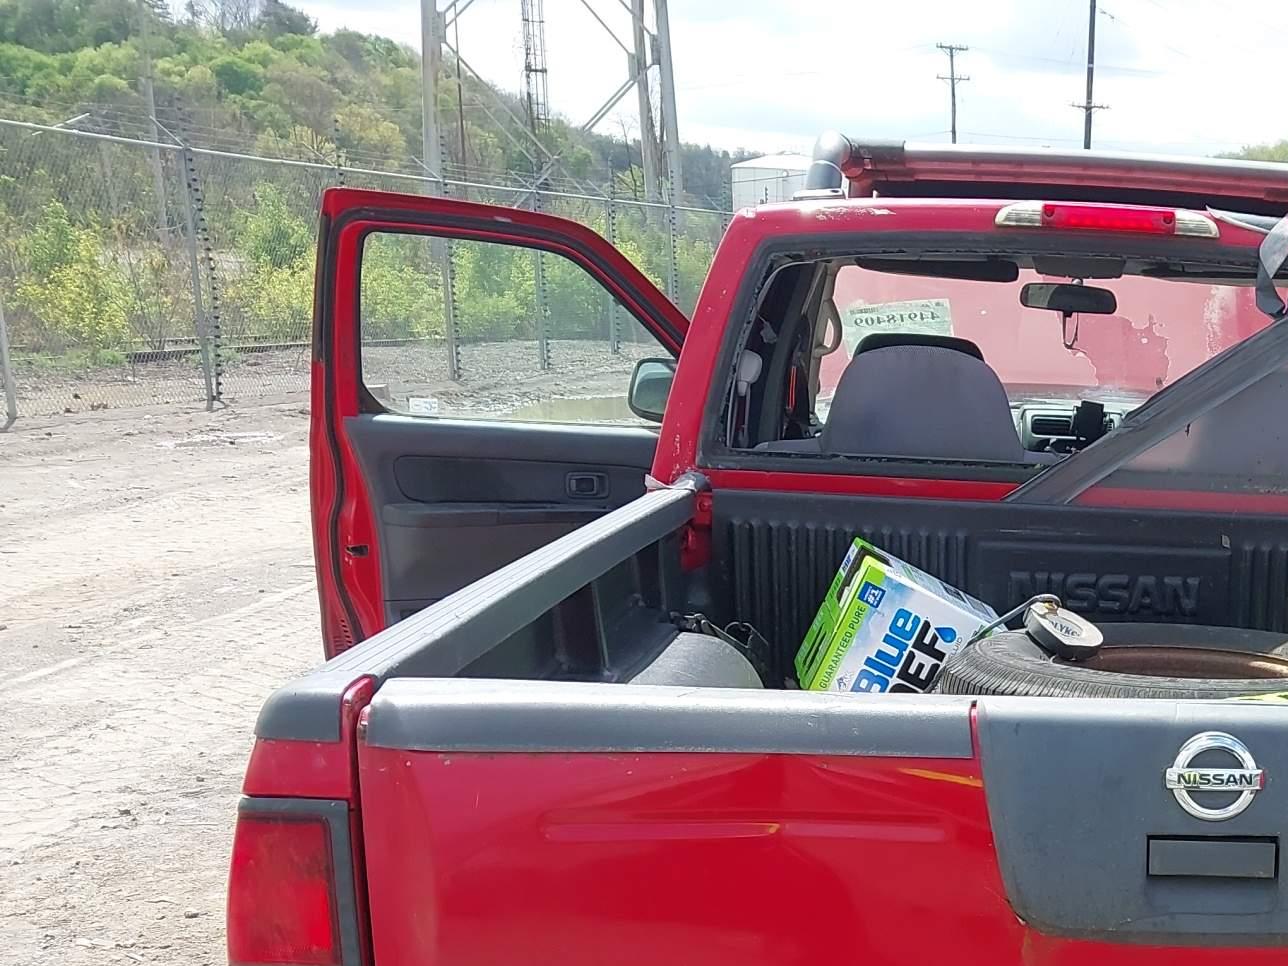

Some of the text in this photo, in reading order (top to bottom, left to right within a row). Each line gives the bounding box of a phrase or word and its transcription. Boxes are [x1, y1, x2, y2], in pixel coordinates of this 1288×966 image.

[1009, 571, 1201, 616] NISSAN
[819, 605, 866, 689] GUARANTEED PURE
[852, 608, 922, 693] Blue
[1177, 772, 1255, 786] NISSAN
